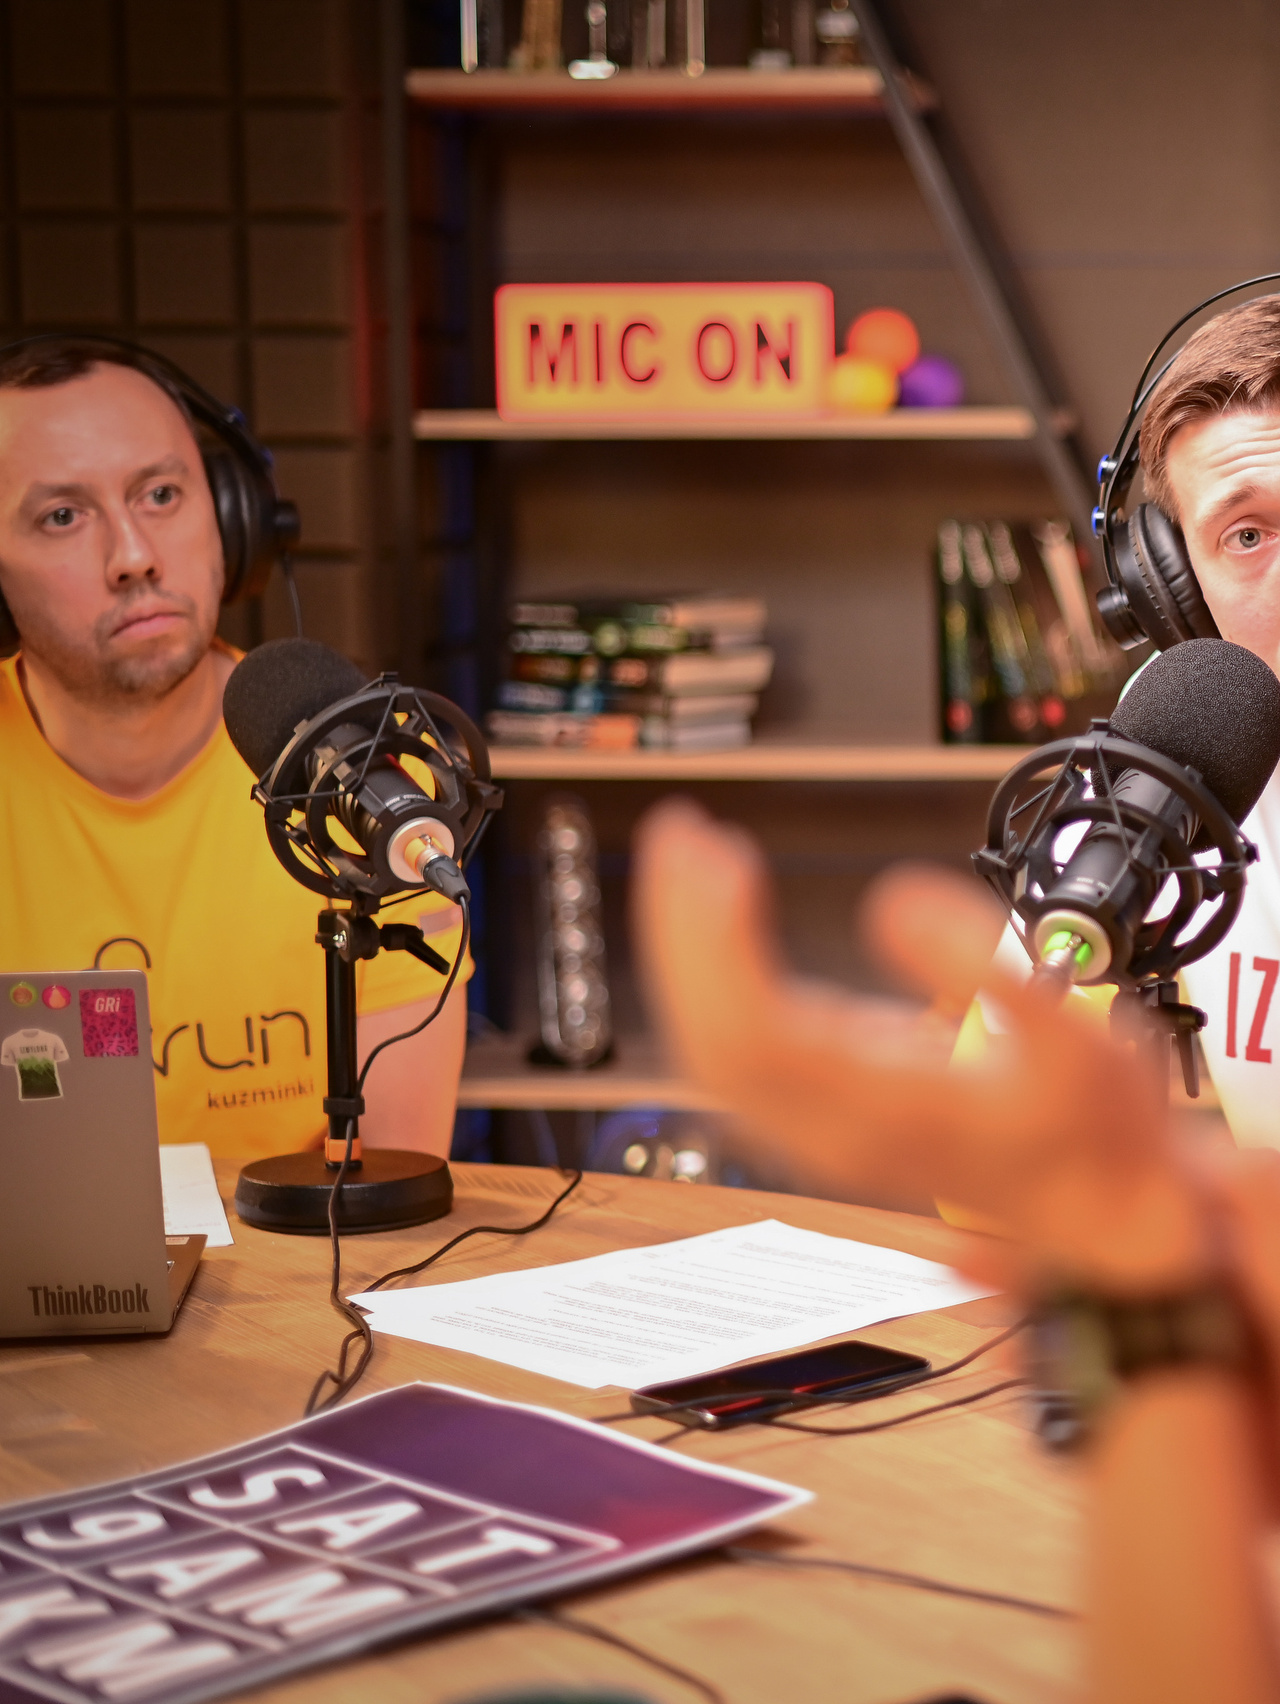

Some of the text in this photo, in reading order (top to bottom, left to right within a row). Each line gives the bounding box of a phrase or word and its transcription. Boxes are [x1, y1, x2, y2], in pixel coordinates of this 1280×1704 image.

[529, 322, 793, 383] MIC ON
[207, 1078, 316, 1109] kuzminki
[27, 1283, 151, 1317] ThinkBook
[189, 1467, 557, 1575] SAT
[22, 1510, 411, 1638] 9AM
